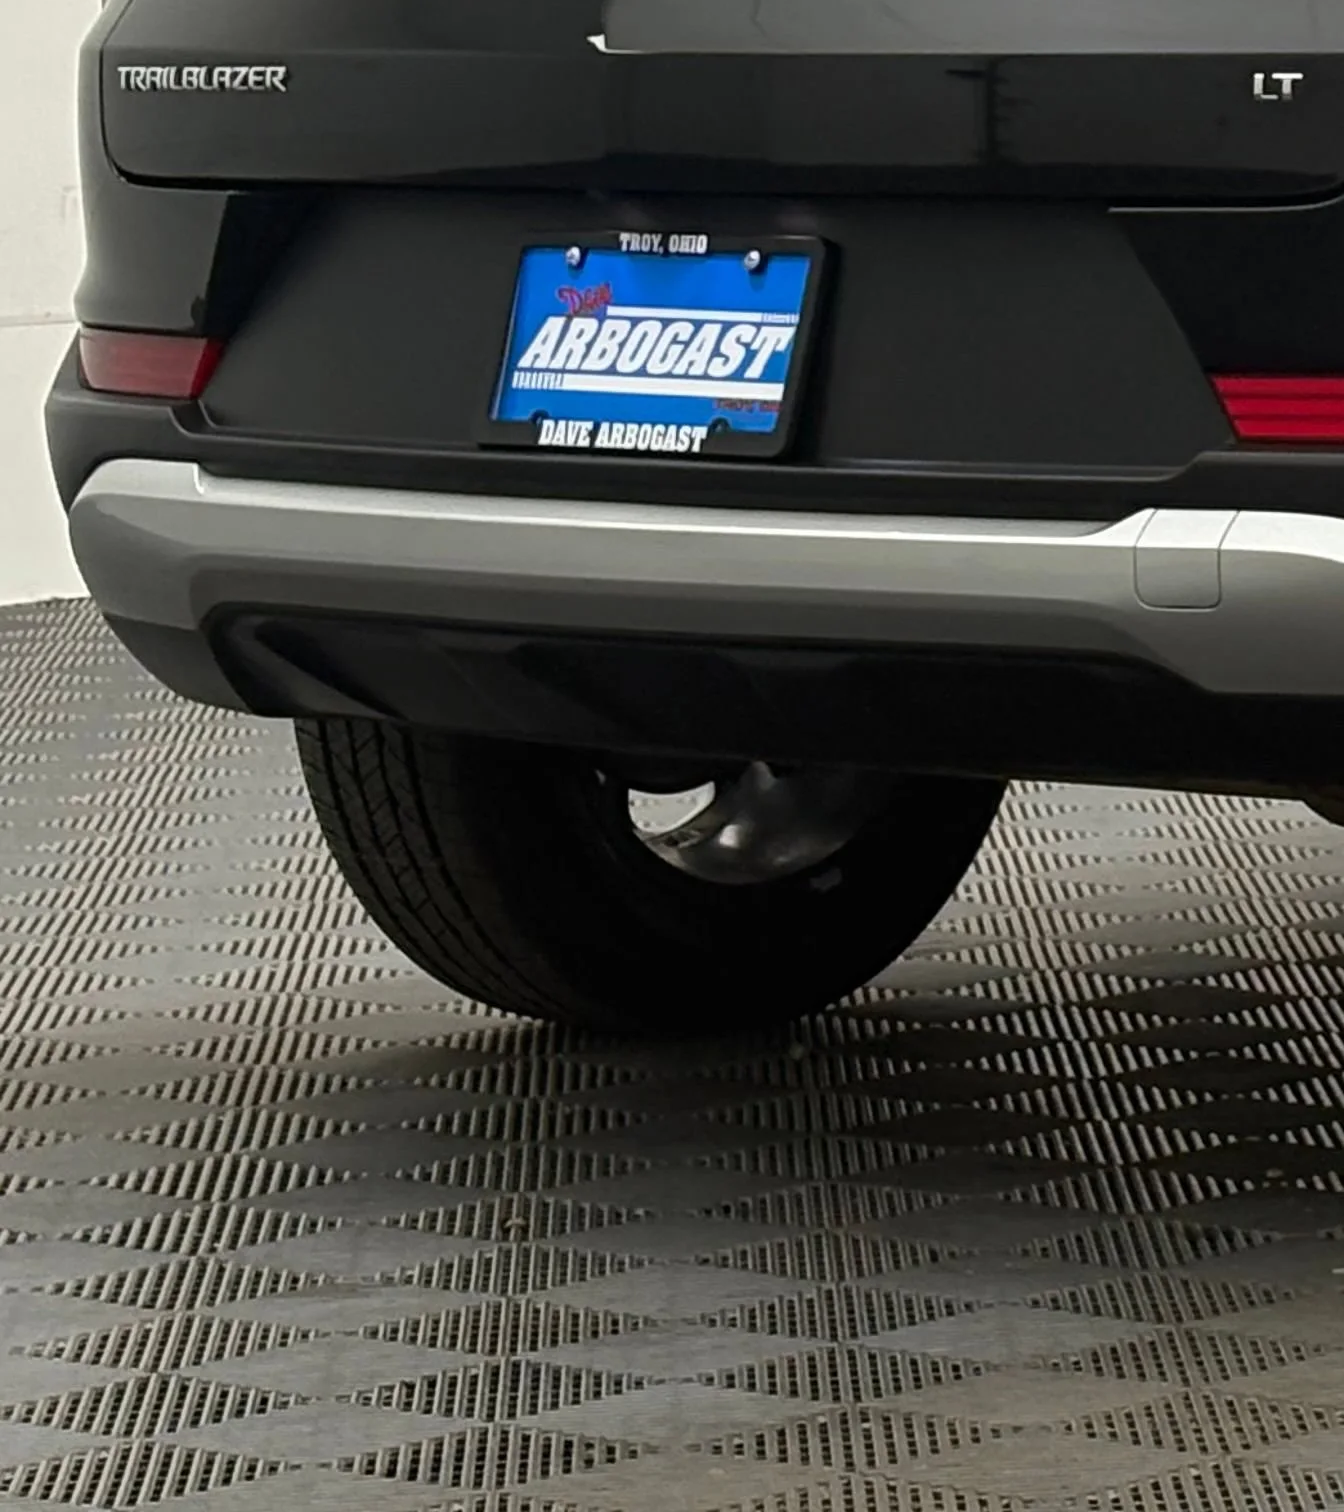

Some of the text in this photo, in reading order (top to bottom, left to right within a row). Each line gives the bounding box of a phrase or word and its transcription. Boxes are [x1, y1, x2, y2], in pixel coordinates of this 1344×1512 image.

[117, 65, 287, 92] TRAILBLAZER
[1253, 72, 1304, 101] LT
[619, 232, 708, 255] TROY, OHIO
[517, 315, 798, 380] ARBOGAST
[538, 419, 708, 453] DAVE ARBOGAST
